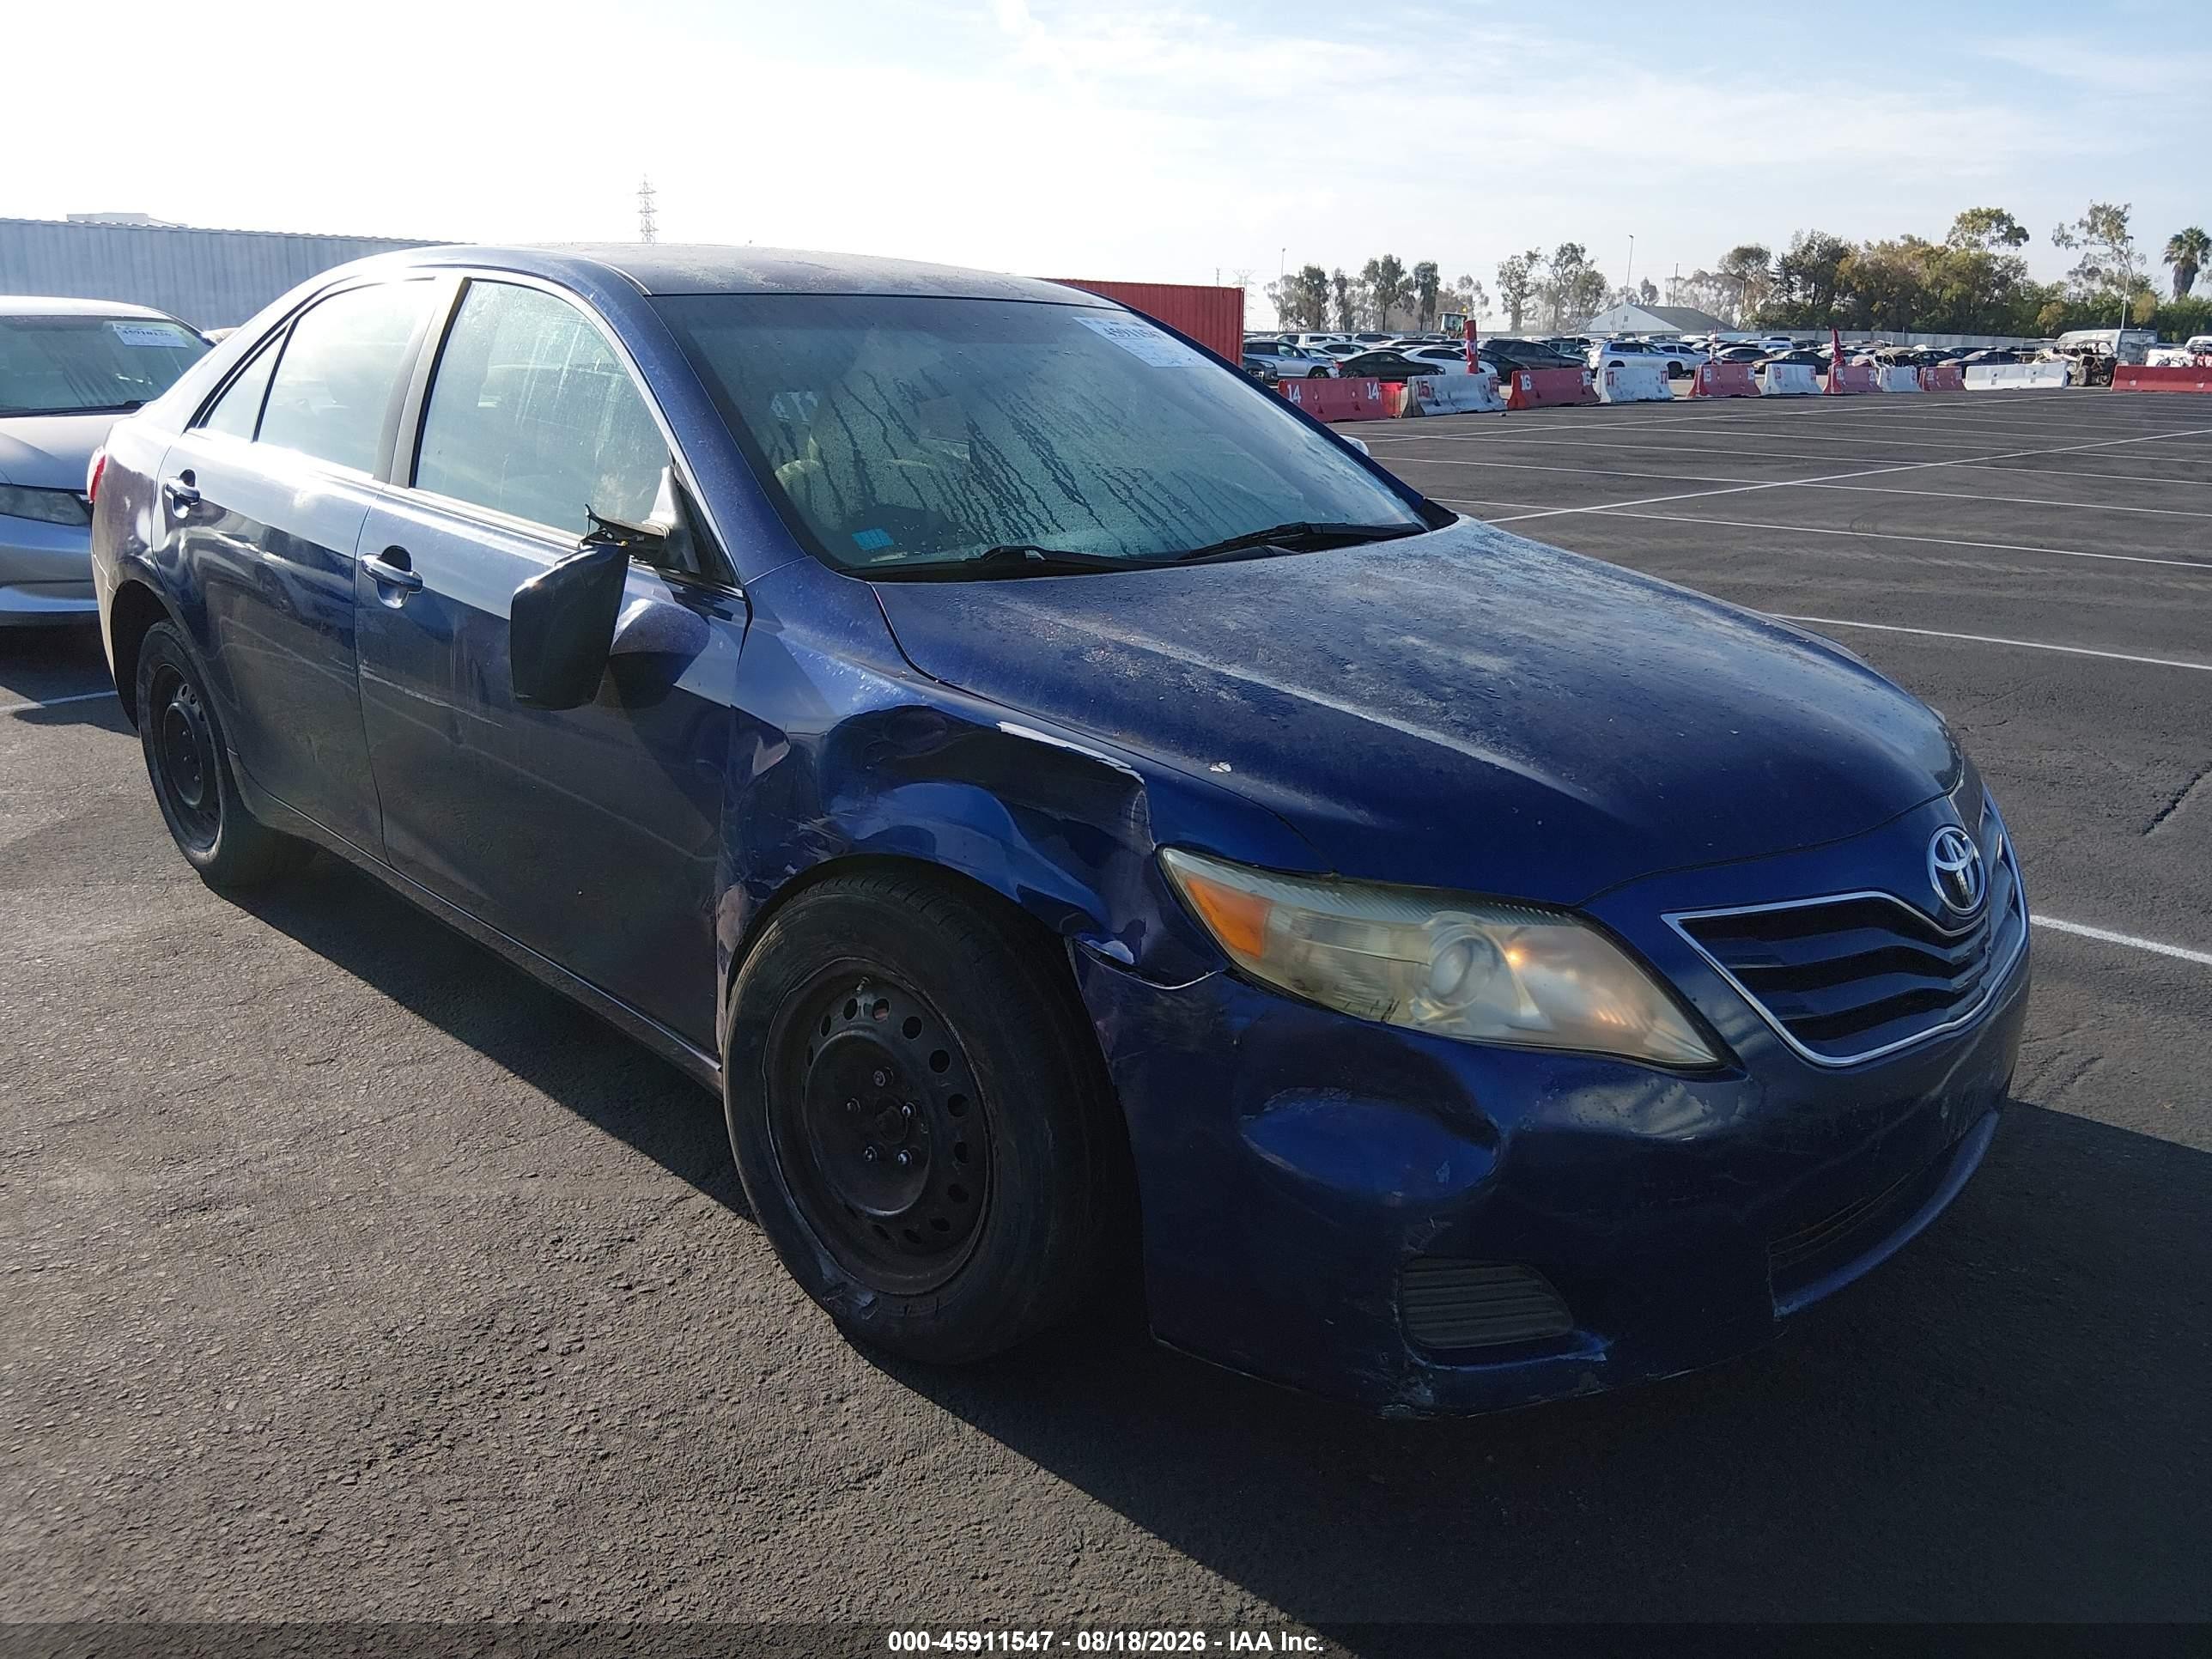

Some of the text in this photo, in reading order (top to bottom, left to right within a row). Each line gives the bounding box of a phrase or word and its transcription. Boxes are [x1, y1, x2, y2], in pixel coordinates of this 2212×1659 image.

[1521, 374, 1532, 391] 16
[1581, 370, 1591, 386] 16
[1606, 370, 1614, 386] 17
[1660, 370, 1668, 385] 17
[1287, 384, 1302, 404] 14
[1366, 381, 1379, 400] 14
[1416, 380, 1430, 398] 15
